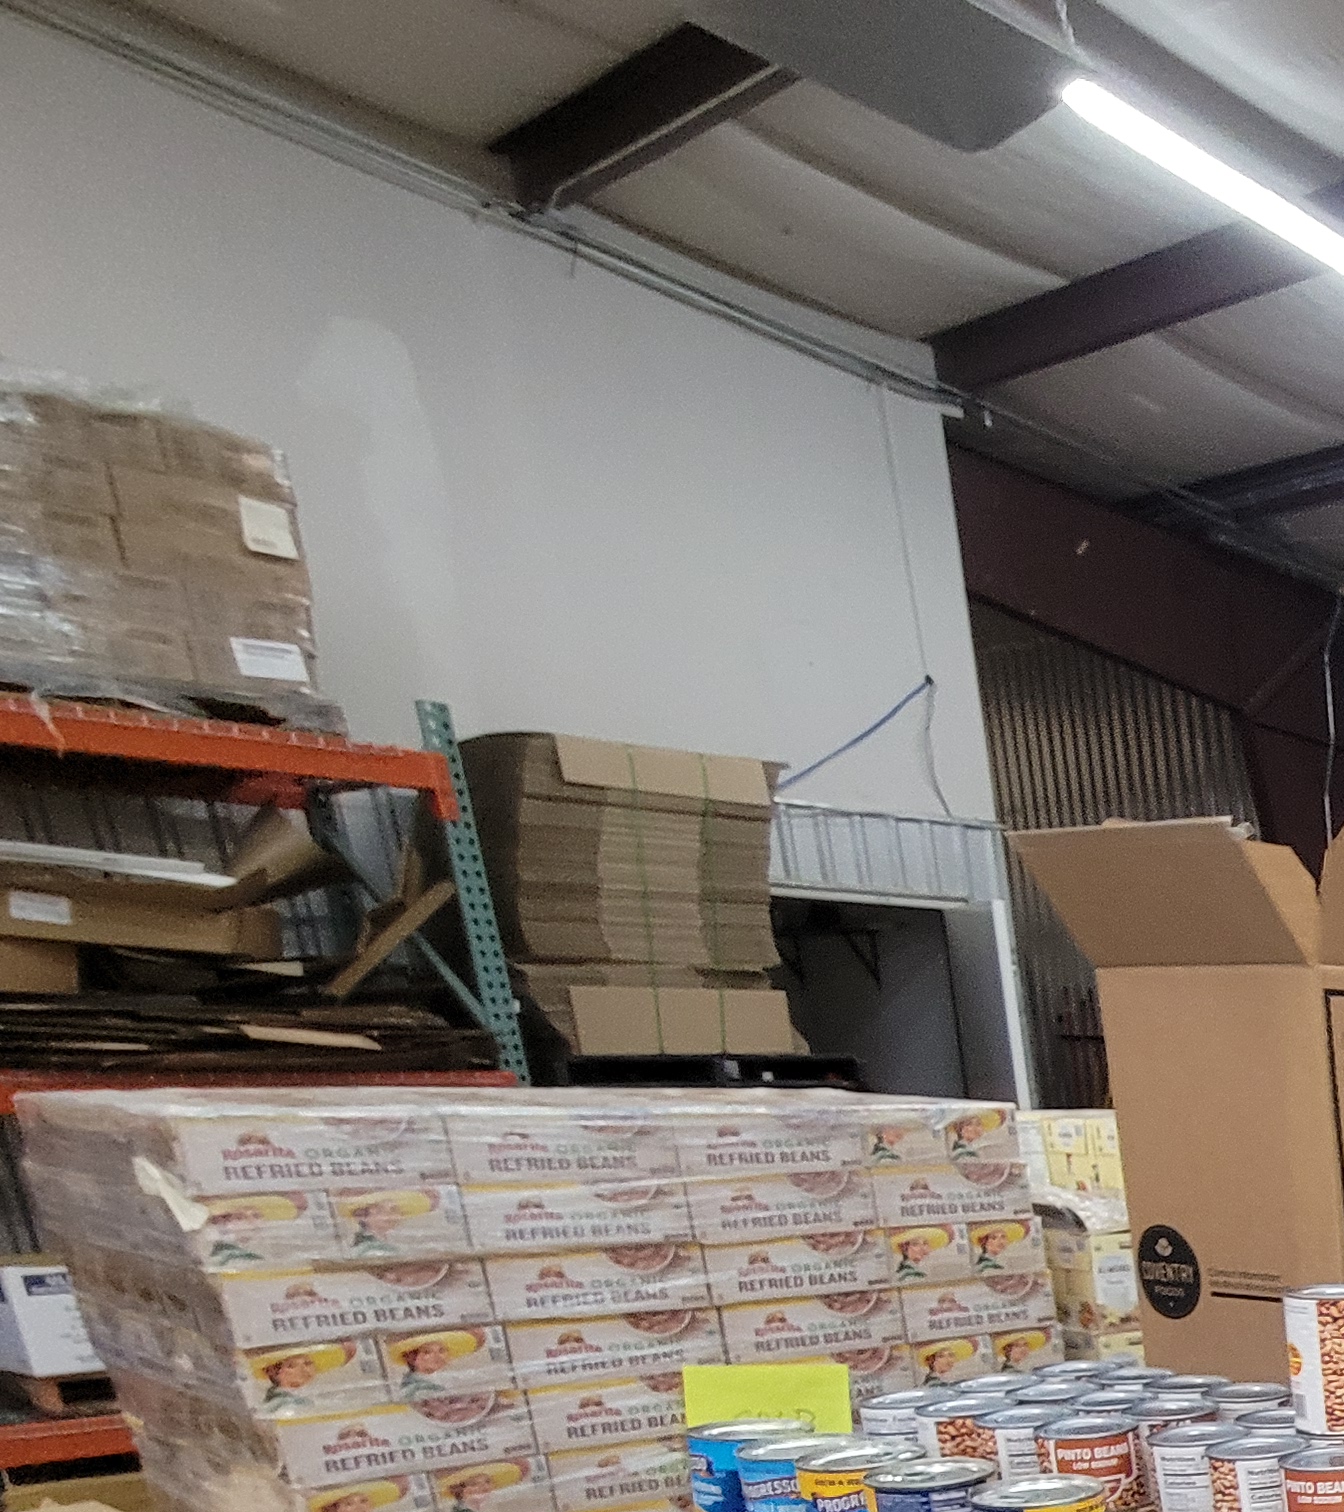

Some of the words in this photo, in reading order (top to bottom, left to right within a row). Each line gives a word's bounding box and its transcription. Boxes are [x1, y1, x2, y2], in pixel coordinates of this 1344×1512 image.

[489, 1156, 571, 1172] REFRIED
[576, 1154, 638, 1169] BEANS
[707, 1152, 774, 1166] REFRIED
[781, 1150, 832, 1164] BEANS
[224, 1163, 323, 1181] REFRIED
[331, 1160, 404, 1177] BEANS
[792, 1210, 843, 1226] BEANS
[901, 1203, 954, 1218] REFRIED
[958, 1201, 1005, 1214] BEANS
[739, 1275, 804, 1292] REFRIED
[809, 1270, 858, 1287] BEANS
[609, 1288, 670, 1303] BEANS
[272, 1310, 367, 1332] REFRIED
[375, 1303, 446, 1323] BEANS
[929, 1314, 984, 1331] REFRIED
[755, 1334, 818, 1351] REFRIED
[823, 1329, 872, 1348] BEANS
[567, 1419, 642, 1438] REFRIED
[422, 1437, 489, 1458] BEANS
[1057, 1447, 1091, 1463] PINTO
[1286, 1480, 1315, 1495] PINTO
